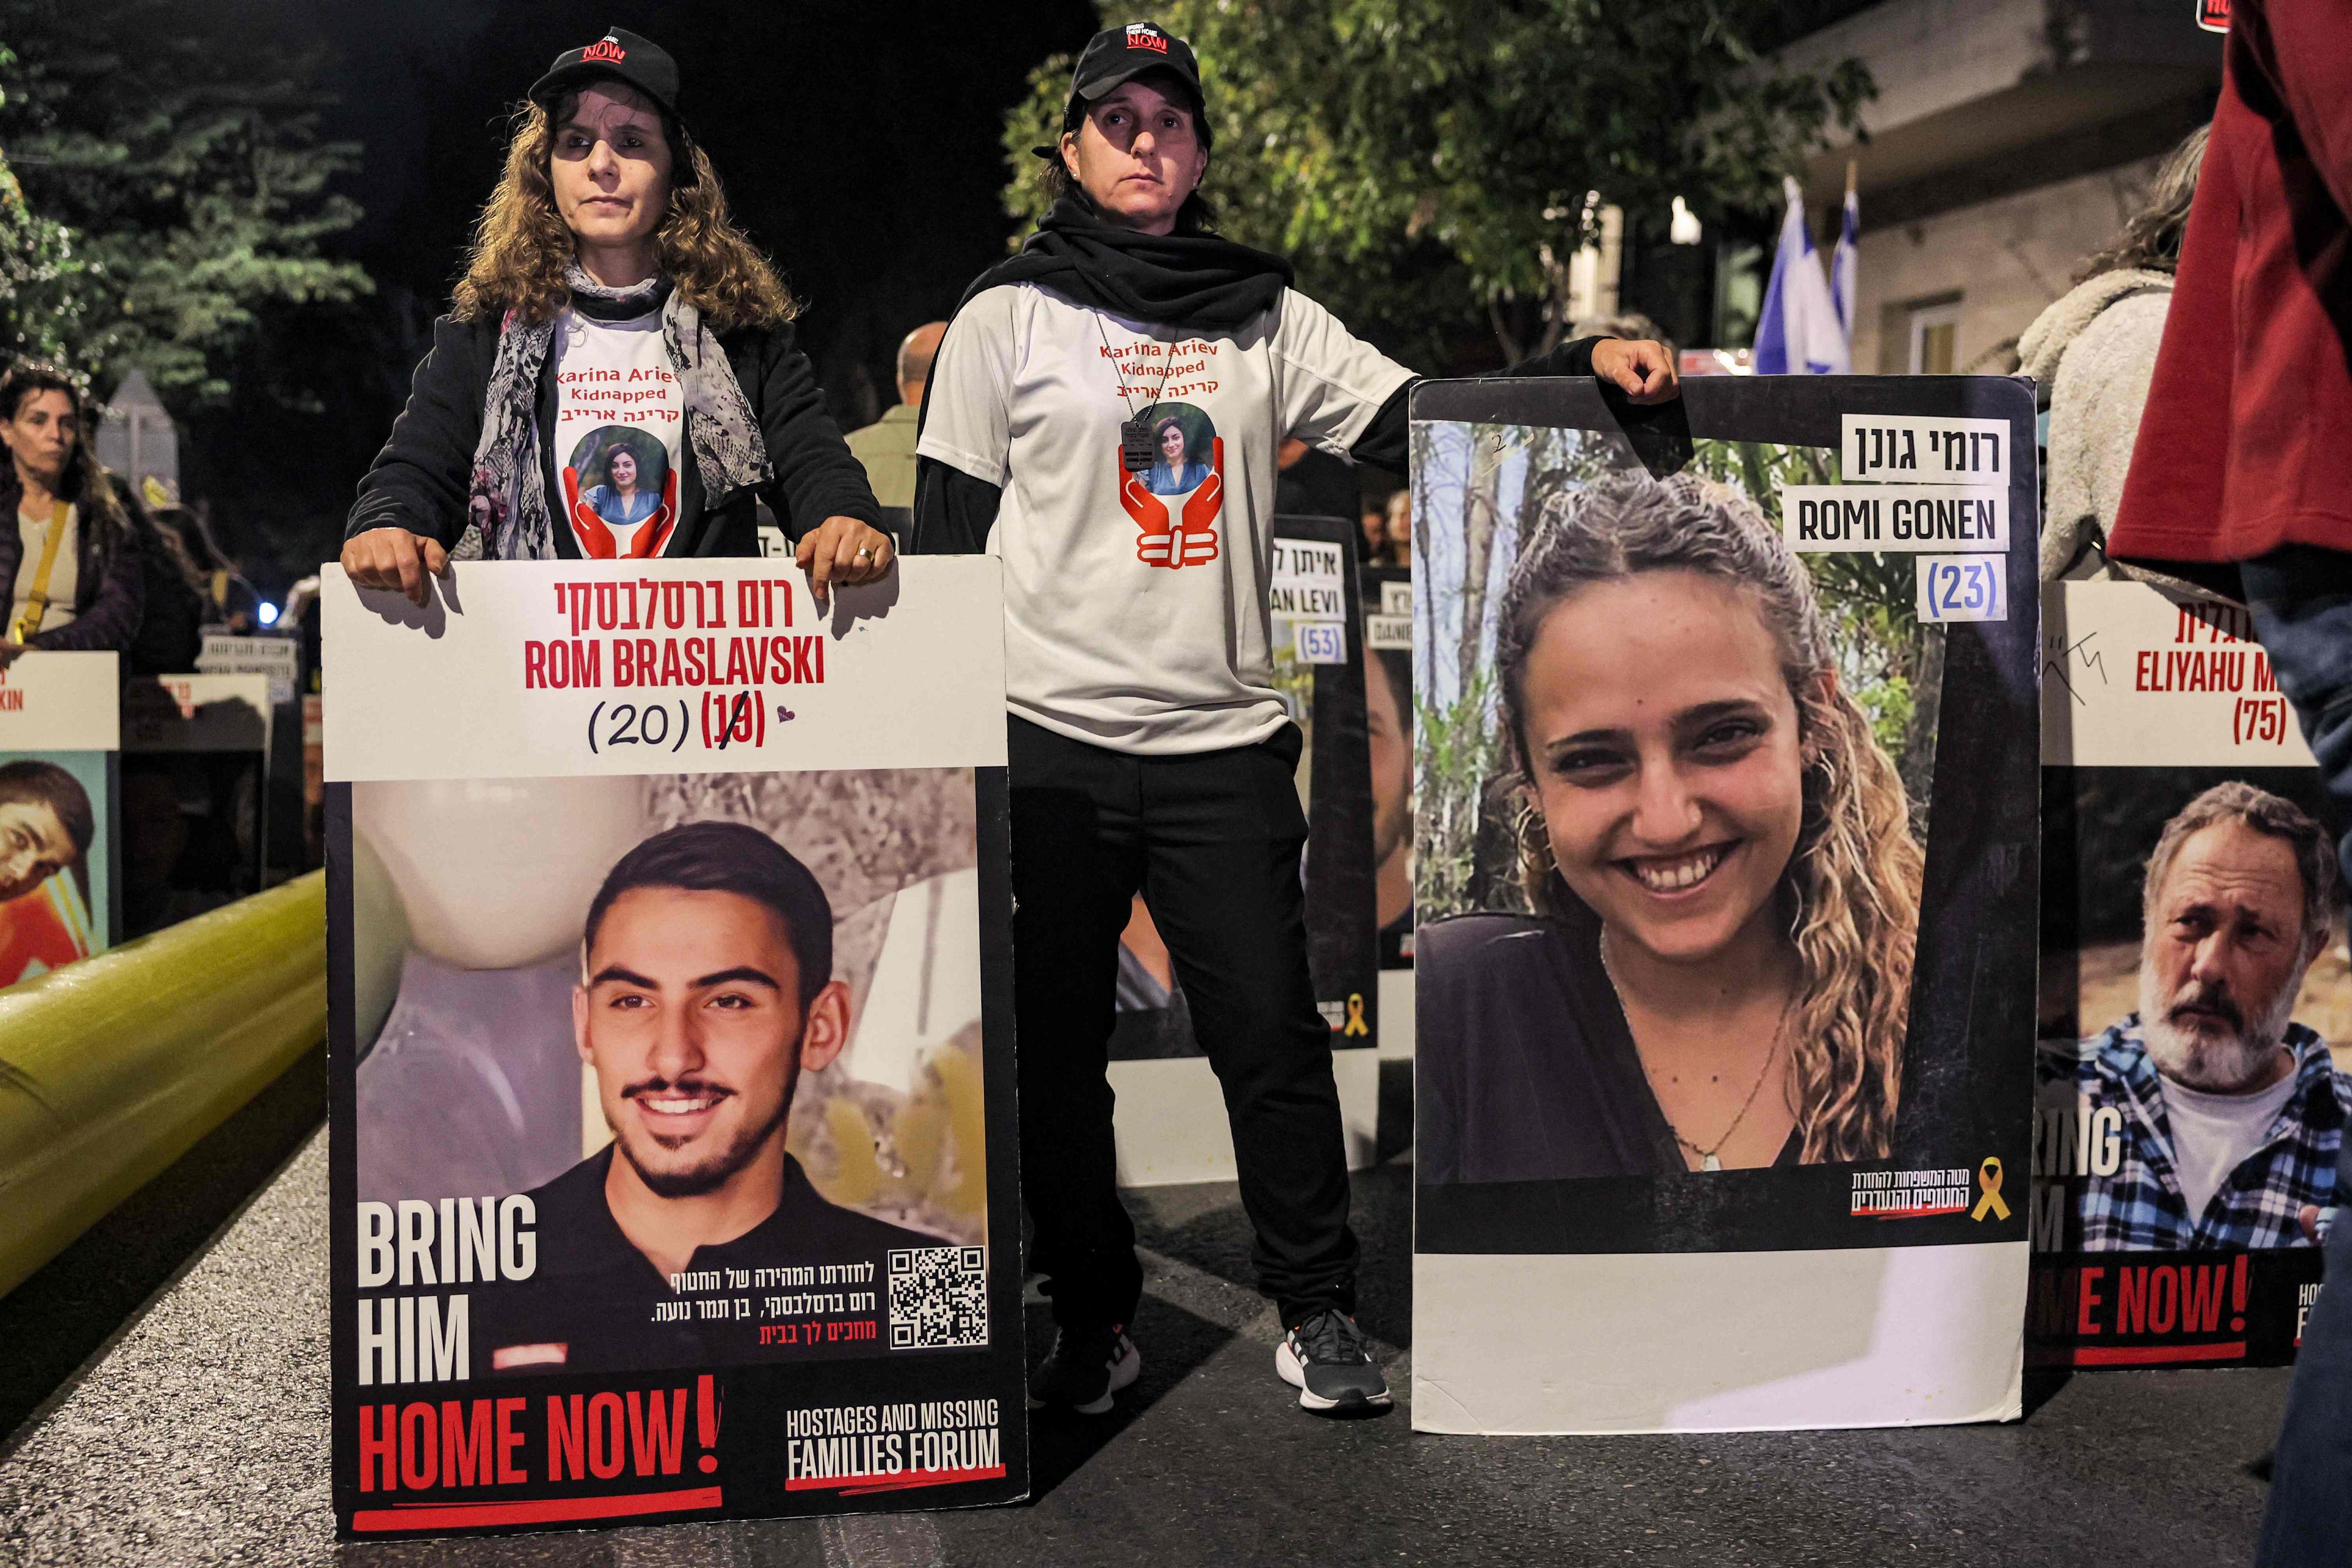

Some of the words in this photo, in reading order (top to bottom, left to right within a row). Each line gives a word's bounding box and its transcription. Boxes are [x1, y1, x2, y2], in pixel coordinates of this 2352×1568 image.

[602, 35, 619, 45] OME
[1127, 34, 1167, 50] NOW
[1141, 28, 1157, 37] HOME
[583, 41, 626, 59] NOW
[1100, 342, 1161, 358] Karina
[1168, 339, 1218, 357] Ariev
[1121, 360, 1205, 379] Kidnapped
[572, 388, 666, 404] Kidnapped
[1117, 385, 1161, 399] ארייב
[1168, 381, 1219, 397] קרינה
[562, 409, 616, 422] ארייב
[624, 409, 679, 423] קרינה
[1855, 428, 1917, 474] גונן
[1929, 431, 1999, 472] רומי
[1799, 500, 1880, 540] ROMI
[1893, 500, 1995, 540] GONEN
[1292, 549, 1337, 576] איתן
[1928, 561, 1996, 617] (23)
[554, 577, 727, 637] ברסלבסקי
[737, 579, 793, 628] רום
[1301, 589, 1338, 613] LEVI
[1301, 627, 1340, 660] (53)
[525, 639, 601, 688] ROM
[613, 636, 824, 687] BRASLAVSKI
[2136, 651, 2245, 691] ELIYAHU
[589, 699, 689, 754] (20)
[701, 690, 766, 748] (19)
[2234, 697, 2286, 745] (75)
[1852, 1171, 1892, 1189] להחזרת
[1893, 1170, 1945, 1188] המשפחות
[1947, 1169, 1970, 1186] מטה
[1852, 1189, 1911, 1212] והנעדרים
[1913, 1186, 1970, 1209] החטופים
[358, 1193, 537, 1288] BRING
[670, 1271, 721, 1295] החטוף
[726, 1267, 750, 1289] של
[755, 1266, 814, 1288] המהירה
[819, 1261, 875, 1285] לחזרתו
[760, 1292, 844, 1318] ברסלבסקי,
[849, 1292, 876, 1312] רום
[2116, 1254, 2249, 1334] NOW!
[651, 1302, 691, 1322] נועה.
[696, 1299, 729, 1319] תמר
[734, 1298, 751, 1320] בן
[358, 1294, 470, 1385] HIM
[759, 1324, 798, 1345] בבית
[802, 1320, 821, 1345] לך
[827, 1320, 877, 1342] מחכים
[786, 1405, 877, 1438] HOSTAGES
[881, 1403, 916, 1432] AND
[921, 1398, 998, 1428] MISSING
[359, 1397, 527, 1492] HOME
[547, 1375, 719, 1482] NOW!
[788, 1433, 902, 1480] FAMILIES
[910, 1428, 1000, 1473] FORUM
